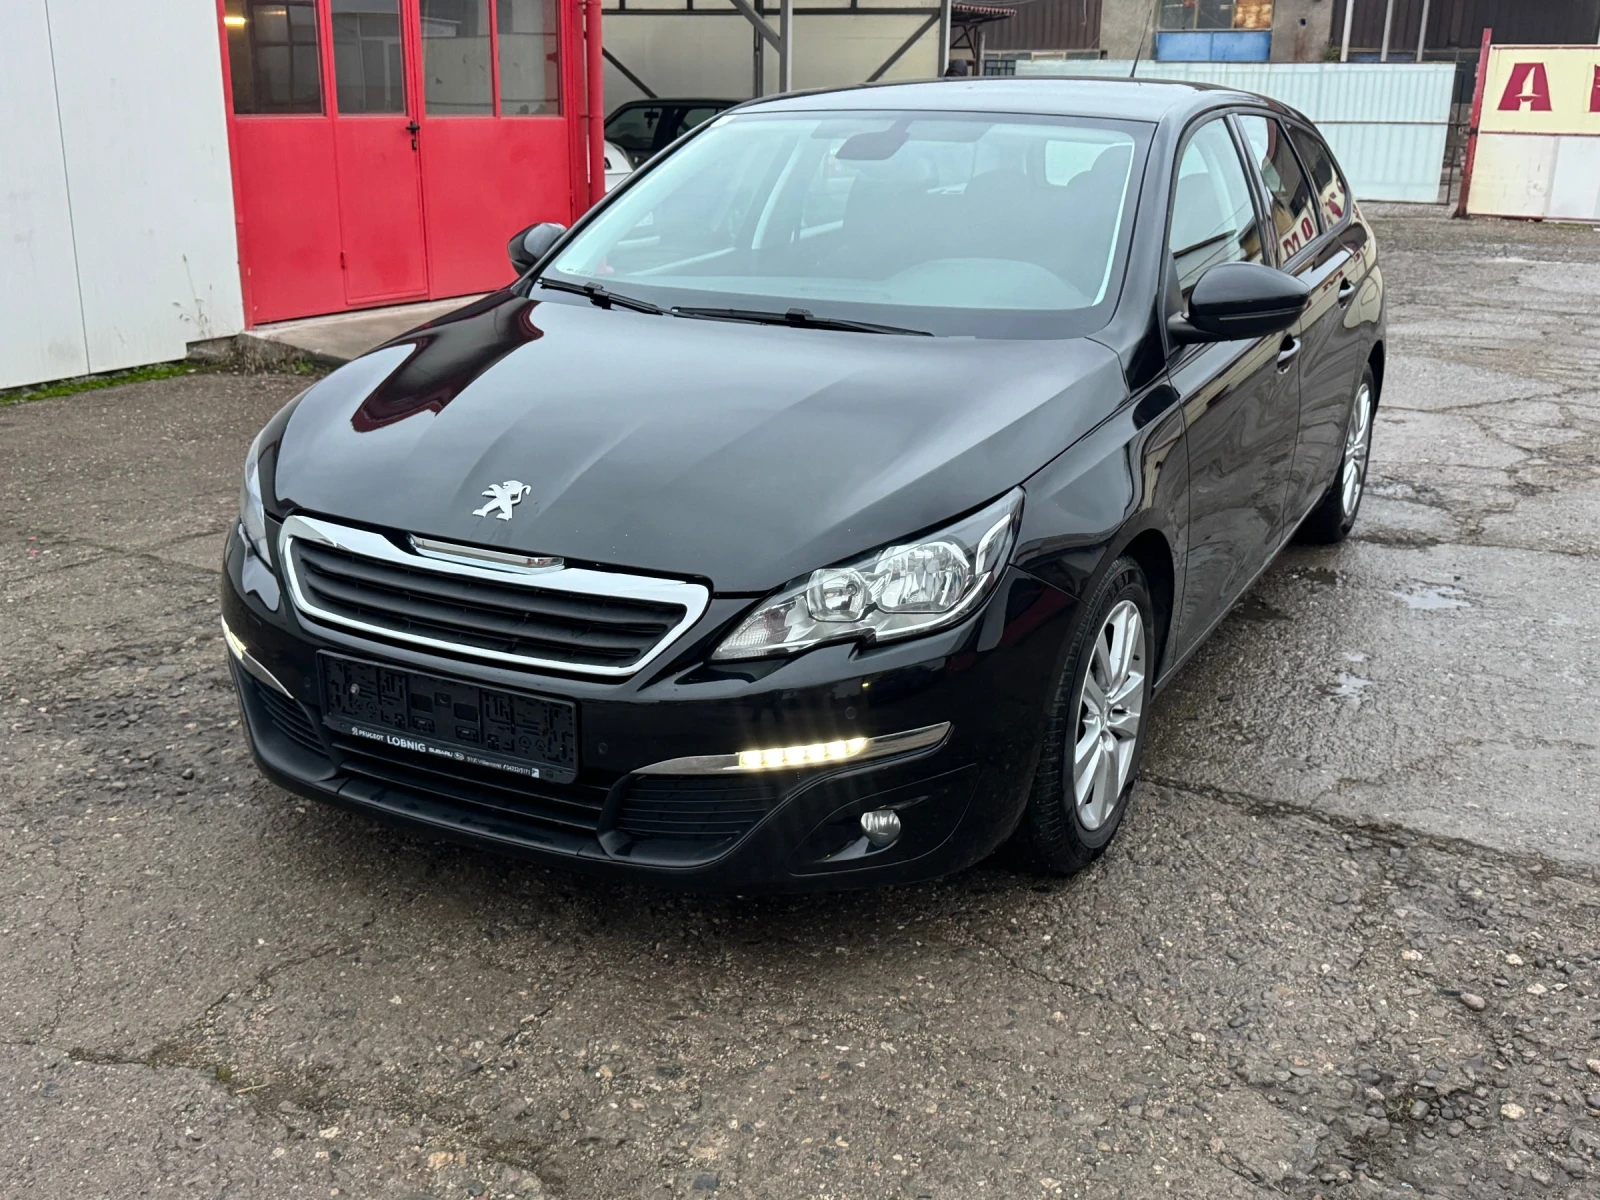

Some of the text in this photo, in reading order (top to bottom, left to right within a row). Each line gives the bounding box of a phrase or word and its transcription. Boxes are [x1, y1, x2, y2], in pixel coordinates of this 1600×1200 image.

[358, 729, 384, 741] PEUGEOT
[387, 735, 426, 753] LOBNIG
[428, 747, 453, 758] SUBARU
